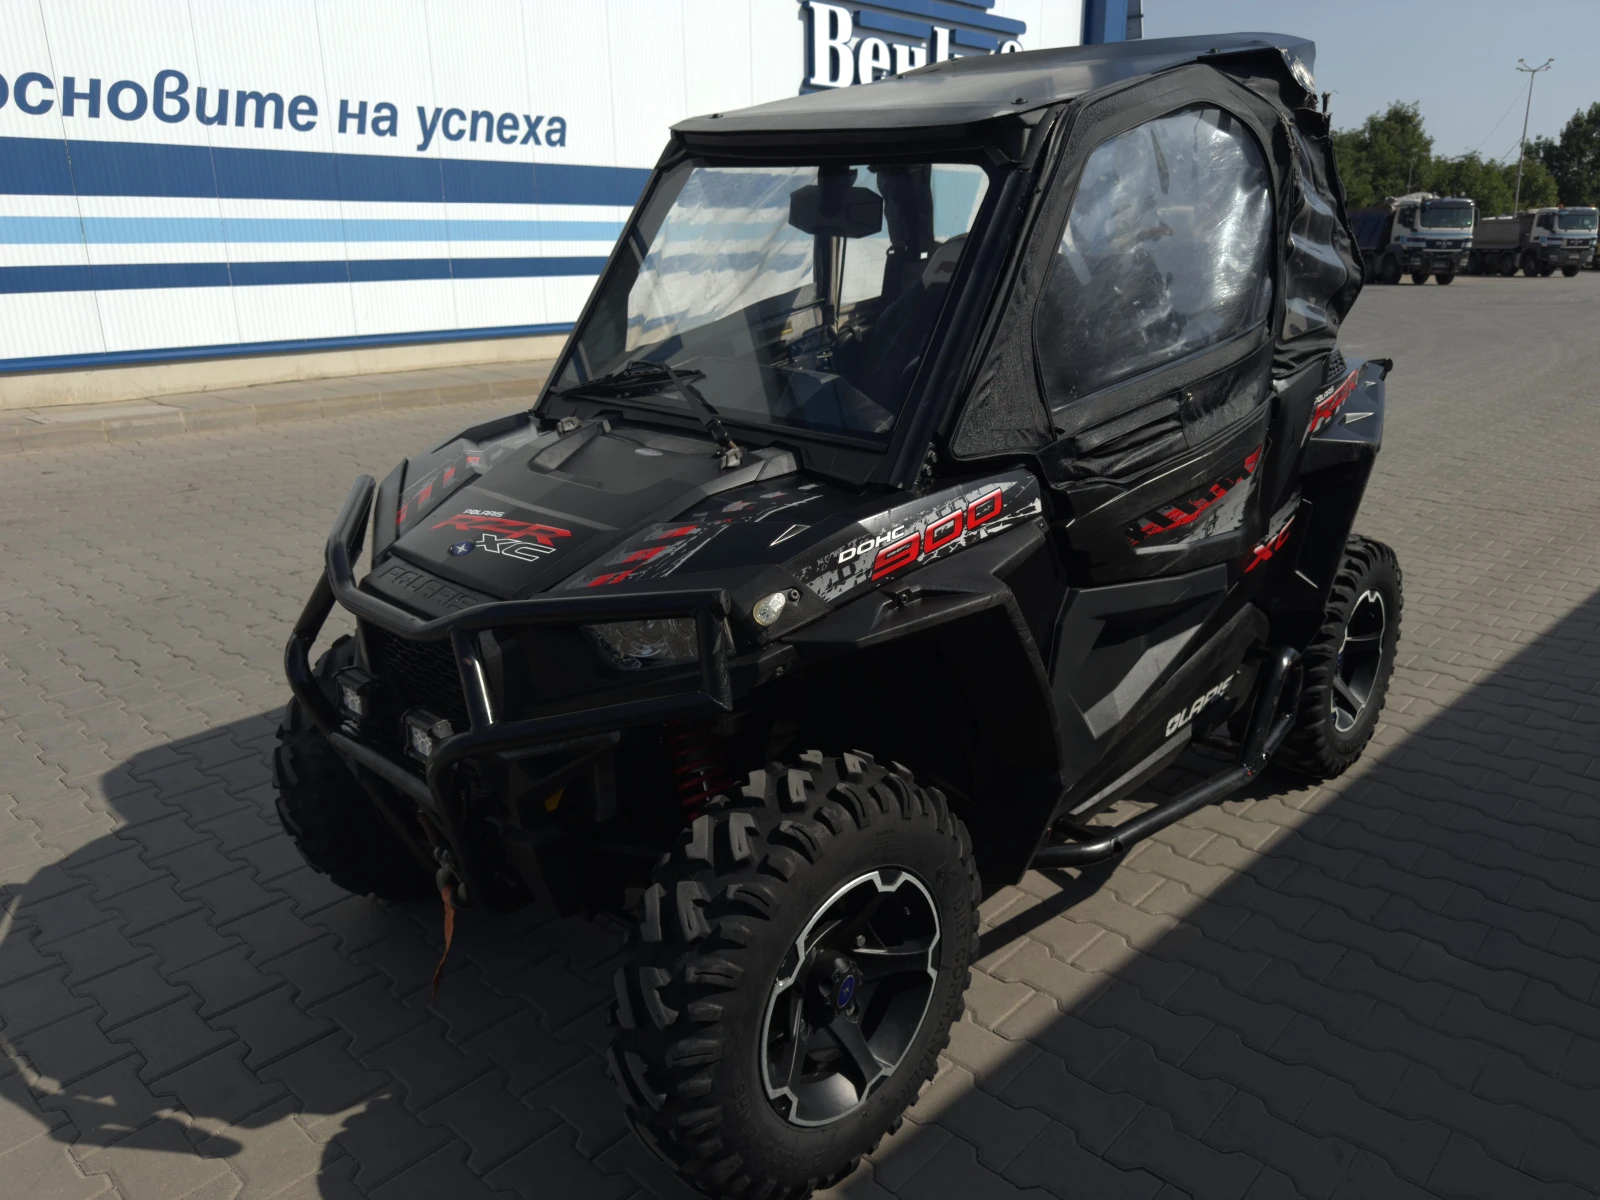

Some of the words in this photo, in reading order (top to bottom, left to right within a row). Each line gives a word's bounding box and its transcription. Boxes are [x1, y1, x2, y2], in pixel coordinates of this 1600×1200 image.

[0, 68, 318, 132] сновите
[337, 99, 399, 138] на
[416, 105, 568, 152] успеха
[429, 514, 573, 547] RZR
[462, 508, 506, 518] POLARIS
[475, 533, 557, 563] XC
[838, 525, 905, 564] DOHC
[871, 487, 1003, 582] 900
